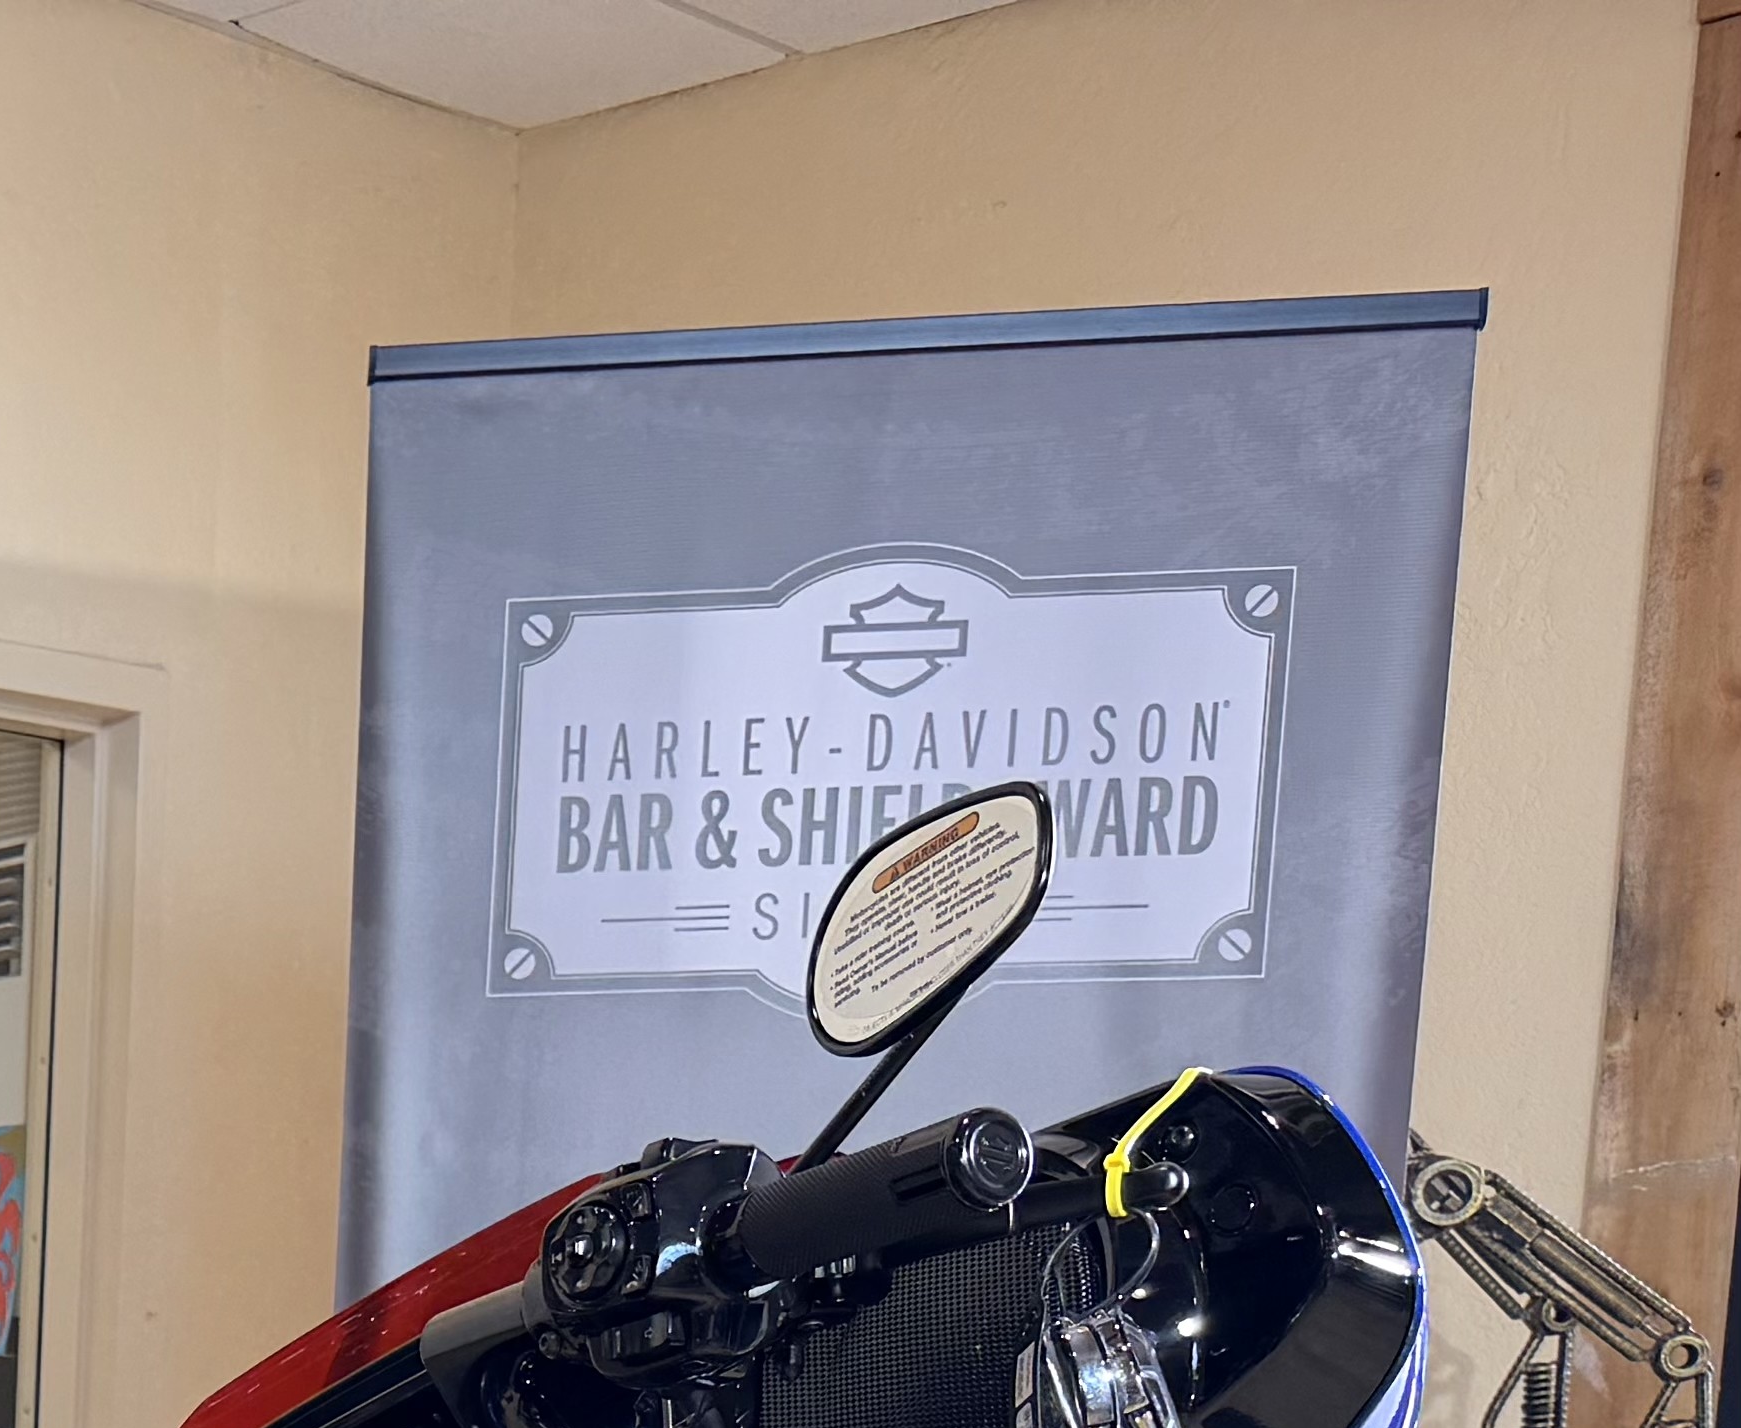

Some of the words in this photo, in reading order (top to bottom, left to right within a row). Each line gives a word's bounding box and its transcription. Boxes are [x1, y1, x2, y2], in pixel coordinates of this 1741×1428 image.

[562, 702, 1219, 782] HARLEY-DAVIDSON
[556, 793, 690, 875] BAR
[695, 790, 738, 868] &
[758, 783, 969, 866] SHIE
[1037, 776, 1218, 858] WARD
[905, 829, 958, 871] WARNING
